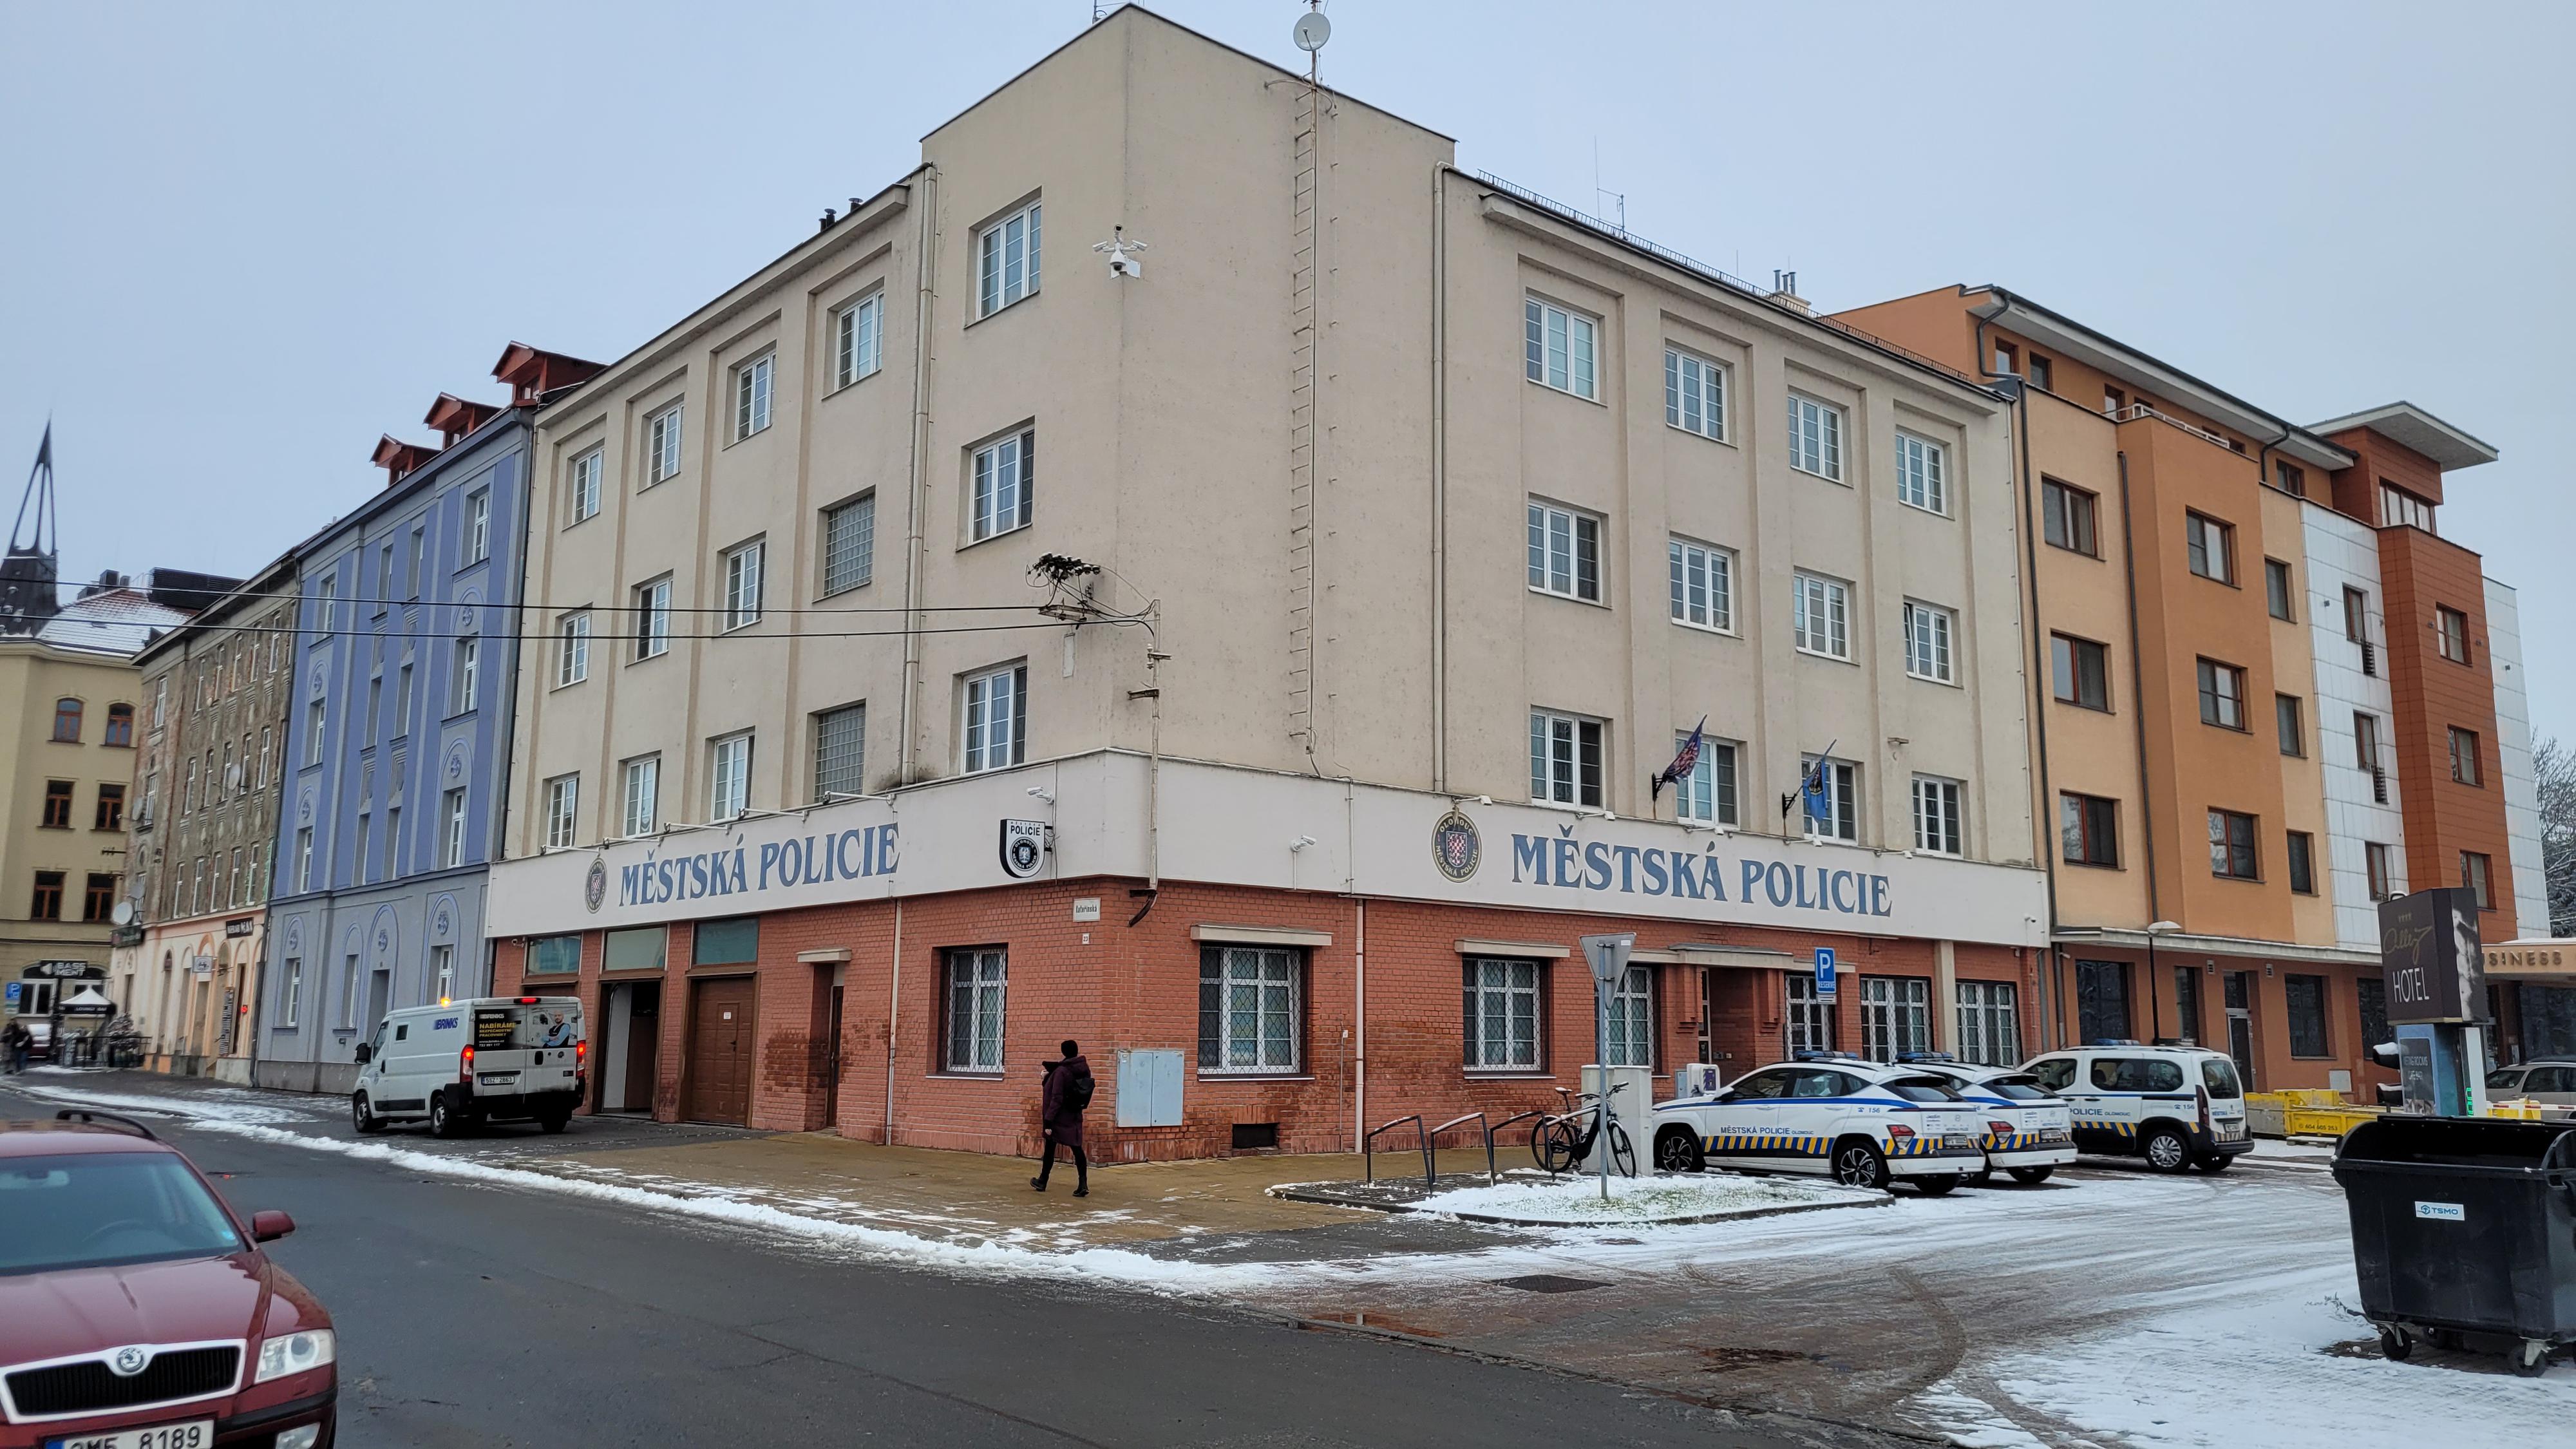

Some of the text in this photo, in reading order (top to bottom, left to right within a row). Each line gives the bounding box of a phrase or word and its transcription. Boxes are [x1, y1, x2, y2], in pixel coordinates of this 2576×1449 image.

[1010, 825, 1041, 836] POLICIE
[619, 833, 749, 907] MĚSTSKÁ
[758, 822, 900, 891] POLICIE
[1460, 849, 1478, 876] POLICIE
[1511, 824, 1893, 918] MĚSTSKÁ POLICIE
[2488, 950, 2562, 967] SINESS
[2392, 967, 2430, 1003] HOTEL
[435, 1017, 459, 1030] BRINKS
[1720, 1124, 1757, 1134] MĚSTSKÁ
[2431, 1206, 2459, 1216] TSMO
[139, 1425, 202, 1449] 8189
